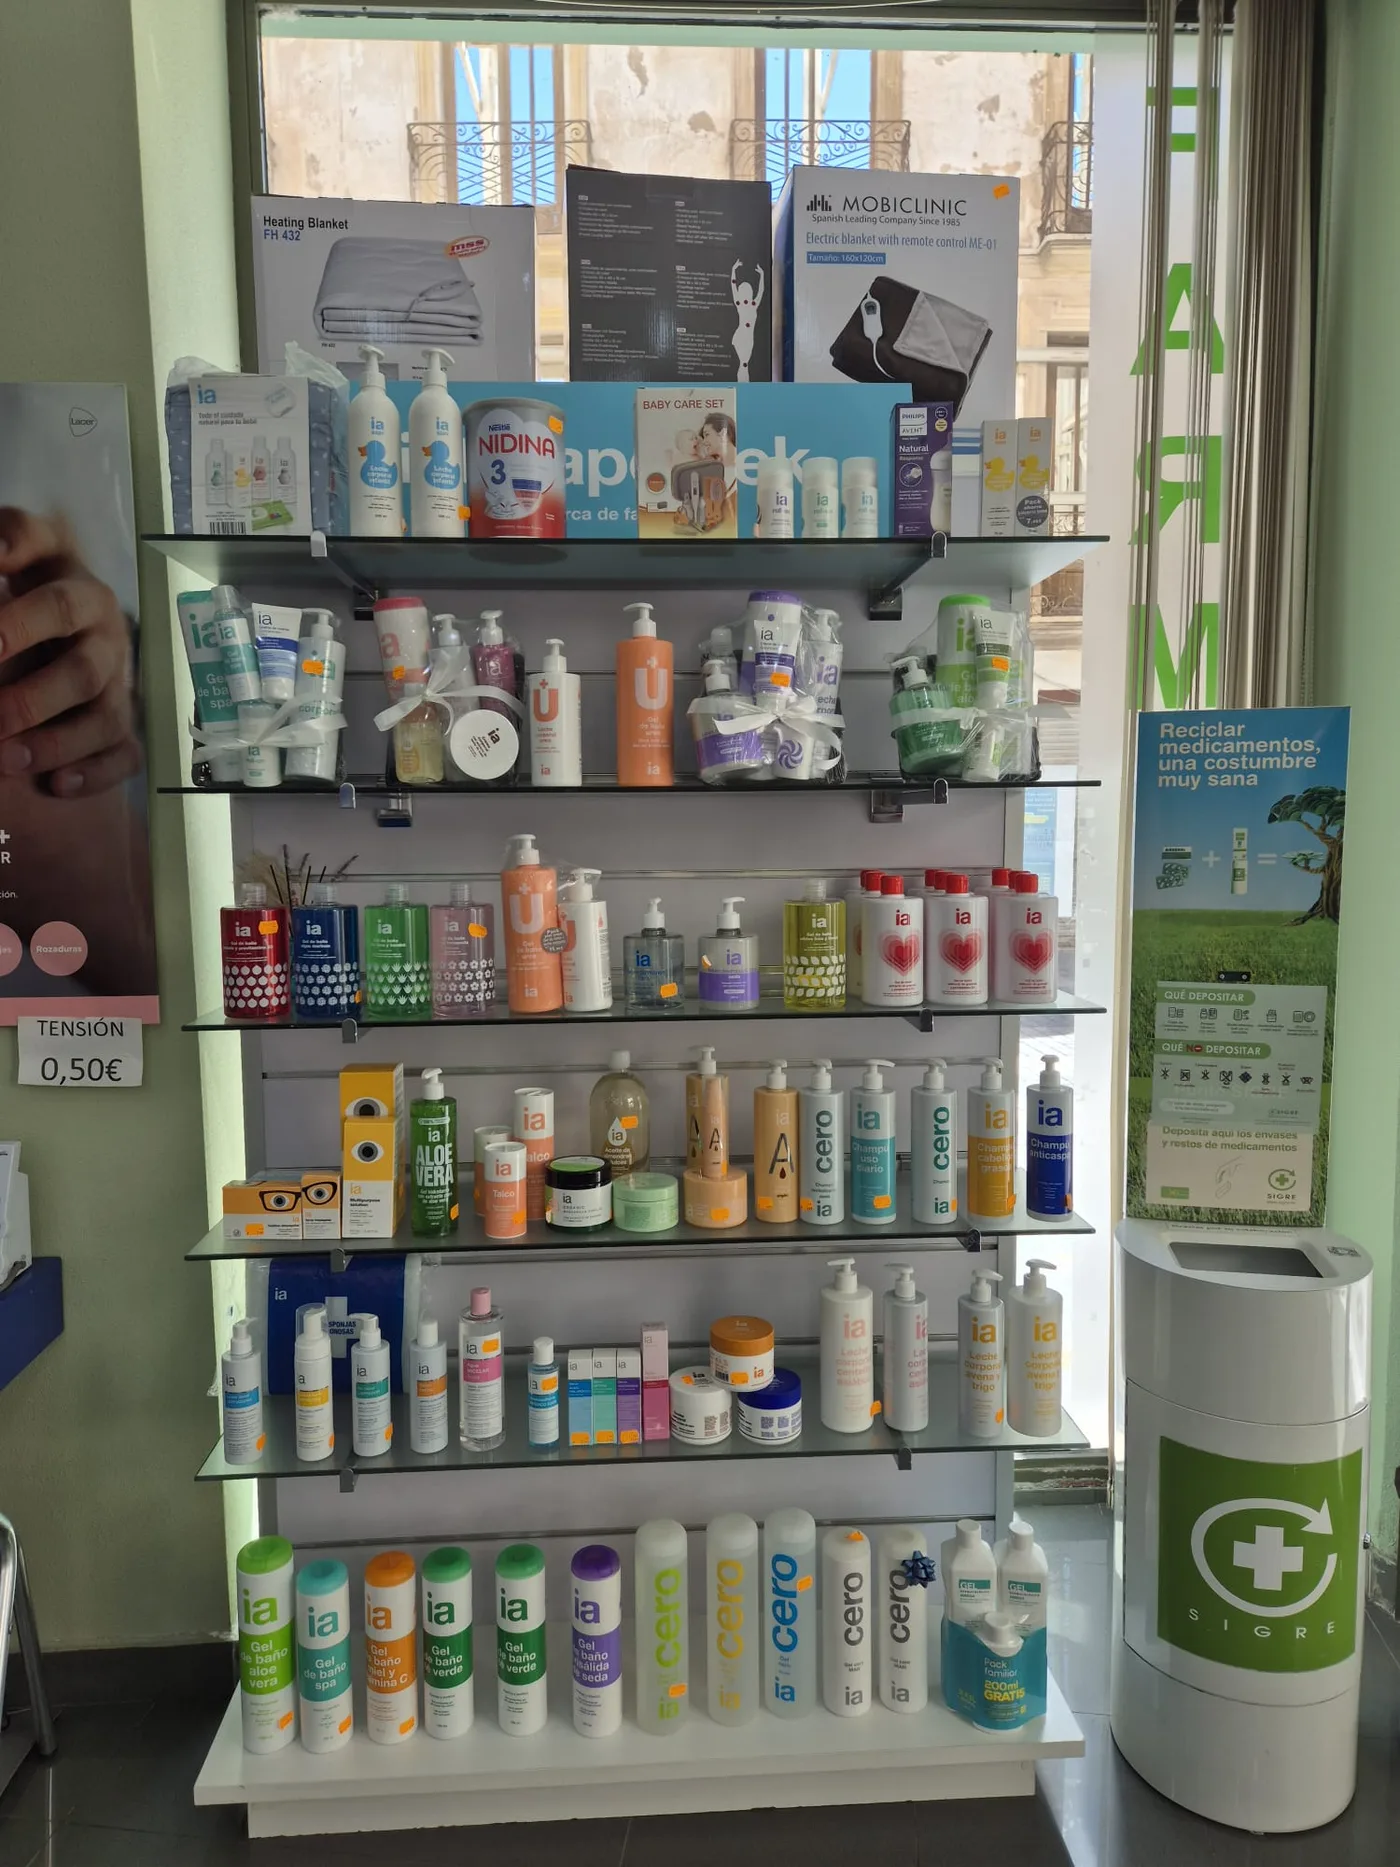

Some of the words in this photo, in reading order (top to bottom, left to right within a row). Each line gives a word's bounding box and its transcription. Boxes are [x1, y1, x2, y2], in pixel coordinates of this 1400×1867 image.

[842, 195, 967, 216] MOBICLINIC
[263, 215, 304, 230] Heating
[308, 217, 349, 230] Blanket
[812, 214, 844, 223] Spanish
[845, 215, 877, 225] Leading
[879, 216, 918, 226] Company
[919, 217, 940, 226] Since
[942, 218, 961, 226] 1985
[263, 229, 279, 241] FH
[282, 230, 301, 241] 432
[806, 232, 840, 245] Electric
[841, 232, 876, 246] blanket
[878, 233, 899, 246] with
[901, 236, 934, 248] remote
[936, 235, 967, 249] control
[969, 237, 997, 250] ME-01
[808, 253, 840, 263] Tamaño:
[841, 254, 884, 264] 160x120cm
[197, 384, 217, 404] ia
[643, 400, 671, 409] BABY
[674, 399, 702, 409] CARE
[705, 399, 724, 408] SET
[370, 416, 384, 430] ia
[436, 416, 449, 430] ia
[488, 423, 511, 432] Nestlé
[479, 433, 555, 458] NIDINA
[899, 444, 929, 454] Natural
[490, 459, 506, 485] 3
[776, 491, 788, 506] ia
[816, 492, 829, 506] ia
[598, 506, 618, 521] de
[258, 611, 273, 626] ia
[980, 616, 992, 629] ia
[218, 622, 236, 641] ia
[760, 627, 774, 641] ia
[206, 674, 225, 684] Ge
[210, 698, 233, 709] spa
[1160, 721, 1245, 738] Reciclar
[1159, 737, 1321, 755] medicamentos,
[647, 761, 661, 776] ia
[1159, 758, 1197, 771] una
[1204, 754, 1316, 770] costumbre
[1158, 774, 1201, 790] muy
[1208, 773, 1258, 786] sana
[811, 913, 827, 928] ia
[895, 909, 910, 926] ia
[955, 908, 971, 925] ia
[1026, 908, 1042, 925] ia
[236, 922, 251, 937] ia
[306, 920, 322, 935] ia
[377, 919, 393, 935] ia
[36, 944, 82, 954] Rozaduras
[635, 950, 650, 967] ia
[726, 949, 742, 965] ia
[1164, 988, 1186, 1000] QUÉ
[1188, 991, 1244, 1002] DEPOSITAR
[37, 1017, 124, 1037] TENSIÓN
[1162, 1041, 1183, 1052] QUÉ
[1206, 1044, 1261, 1056] DEPOSITAR
[41, 1058, 122, 1086] 0,50€
[523, 1107, 545, 1131] ia
[857, 1103, 880, 1130] ia
[985, 1102, 1009, 1129] ia
[1038, 1100, 1063, 1127] ia
[428, 1127, 441, 1142] ia
[611, 1128, 624, 1141] ia
[933, 1106, 950, 1170] cero
[1162, 1125, 1208, 1138] Deposita
[1236, 1129, 1252, 1138] los
[1255, 1130, 1298, 1140] envases
[816, 1110, 833, 1174] cero
[1169, 1138, 1203, 1149] restos
[1205, 1139, 1217, 1150] de
[1220, 1140, 1298, 1152] medicamentos
[416, 1143, 453, 1166] ALOE
[527, 1151, 550, 1163] alco
[860, 1155, 879, 1164] uso
[495, 1160, 512, 1176] ia
[856, 1164, 885, 1174] diario
[416, 1165, 454, 1187] VERA
[493, 1189, 515, 1198] Talco
[817, 1200, 832, 1217] ia
[934, 1197, 949, 1214] ia
[275, 1287, 287, 1301] ia
[843, 1314, 866, 1340] ia
[972, 1316, 996, 1343] ia
[1033, 1317, 1057, 1342] ia
[466, 1341, 478, 1354] ia
[356, 1363, 367, 1377] ia
[418, 1362, 430, 1375] ia
[753, 1367, 764, 1379] ia
[225, 1373, 236, 1387] ia
[972, 1381, 995, 1393] trigo
[960, 1581, 977, 1589] GEL
[1009, 1583, 1026, 1591] GEL
[242, 1588, 278, 1625] ia
[366, 1592, 392, 1629] ia
[427, 1592, 455, 1625] ia
[500, 1588, 528, 1622] ia
[575, 1588, 600, 1624] ia
[717, 1559, 744, 1659] cero
[771, 1554, 798, 1652] cero
[844, 1572, 864, 1646] cero
[889, 1569, 911, 1644] cero
[308, 1606, 339, 1638] ia
[655, 1568, 681, 1668] cero
[1188, 1608, 1335, 1639] SIGRE
[250, 1640, 273, 1652] Gel
[370, 1645, 388, 1656] Gel
[431, 1645, 450, 1656] Gel
[505, 1641, 523, 1652] Gel
[578, 1638, 595, 1651] Gel
[240, 1652, 252, 1662] de
[256, 1647, 288, 1663] baño
[315, 1656, 335, 1669] Gel
[373, 1655, 401, 1667] baño
[435, 1654, 463, 1667] baño
[509, 1651, 536, 1663] baño
[581, 1650, 608, 1662] baño
[249, 1665, 277, 1676] aloe
[303, 1667, 316, 1679] de
[319, 1661, 346, 1678] baño
[432, 1664, 463, 1677] verde
[507, 1661, 537, 1674] verde
[984, 1658, 1007, 1668] Pack
[388, 1668, 396, 1678] y
[399, 1673, 408, 1684] C
[582, 1671, 608, 1683] seda
[984, 1667, 1017, 1678] familiar
[249, 1676, 278, 1688] vera
[315, 1678, 337, 1690] spa
[984, 1679, 1019, 1691] 200ml
[845, 1686, 864, 1705] ia
[891, 1681, 910, 1702] ia
[983, 1688, 1025, 1702] GRATIS
